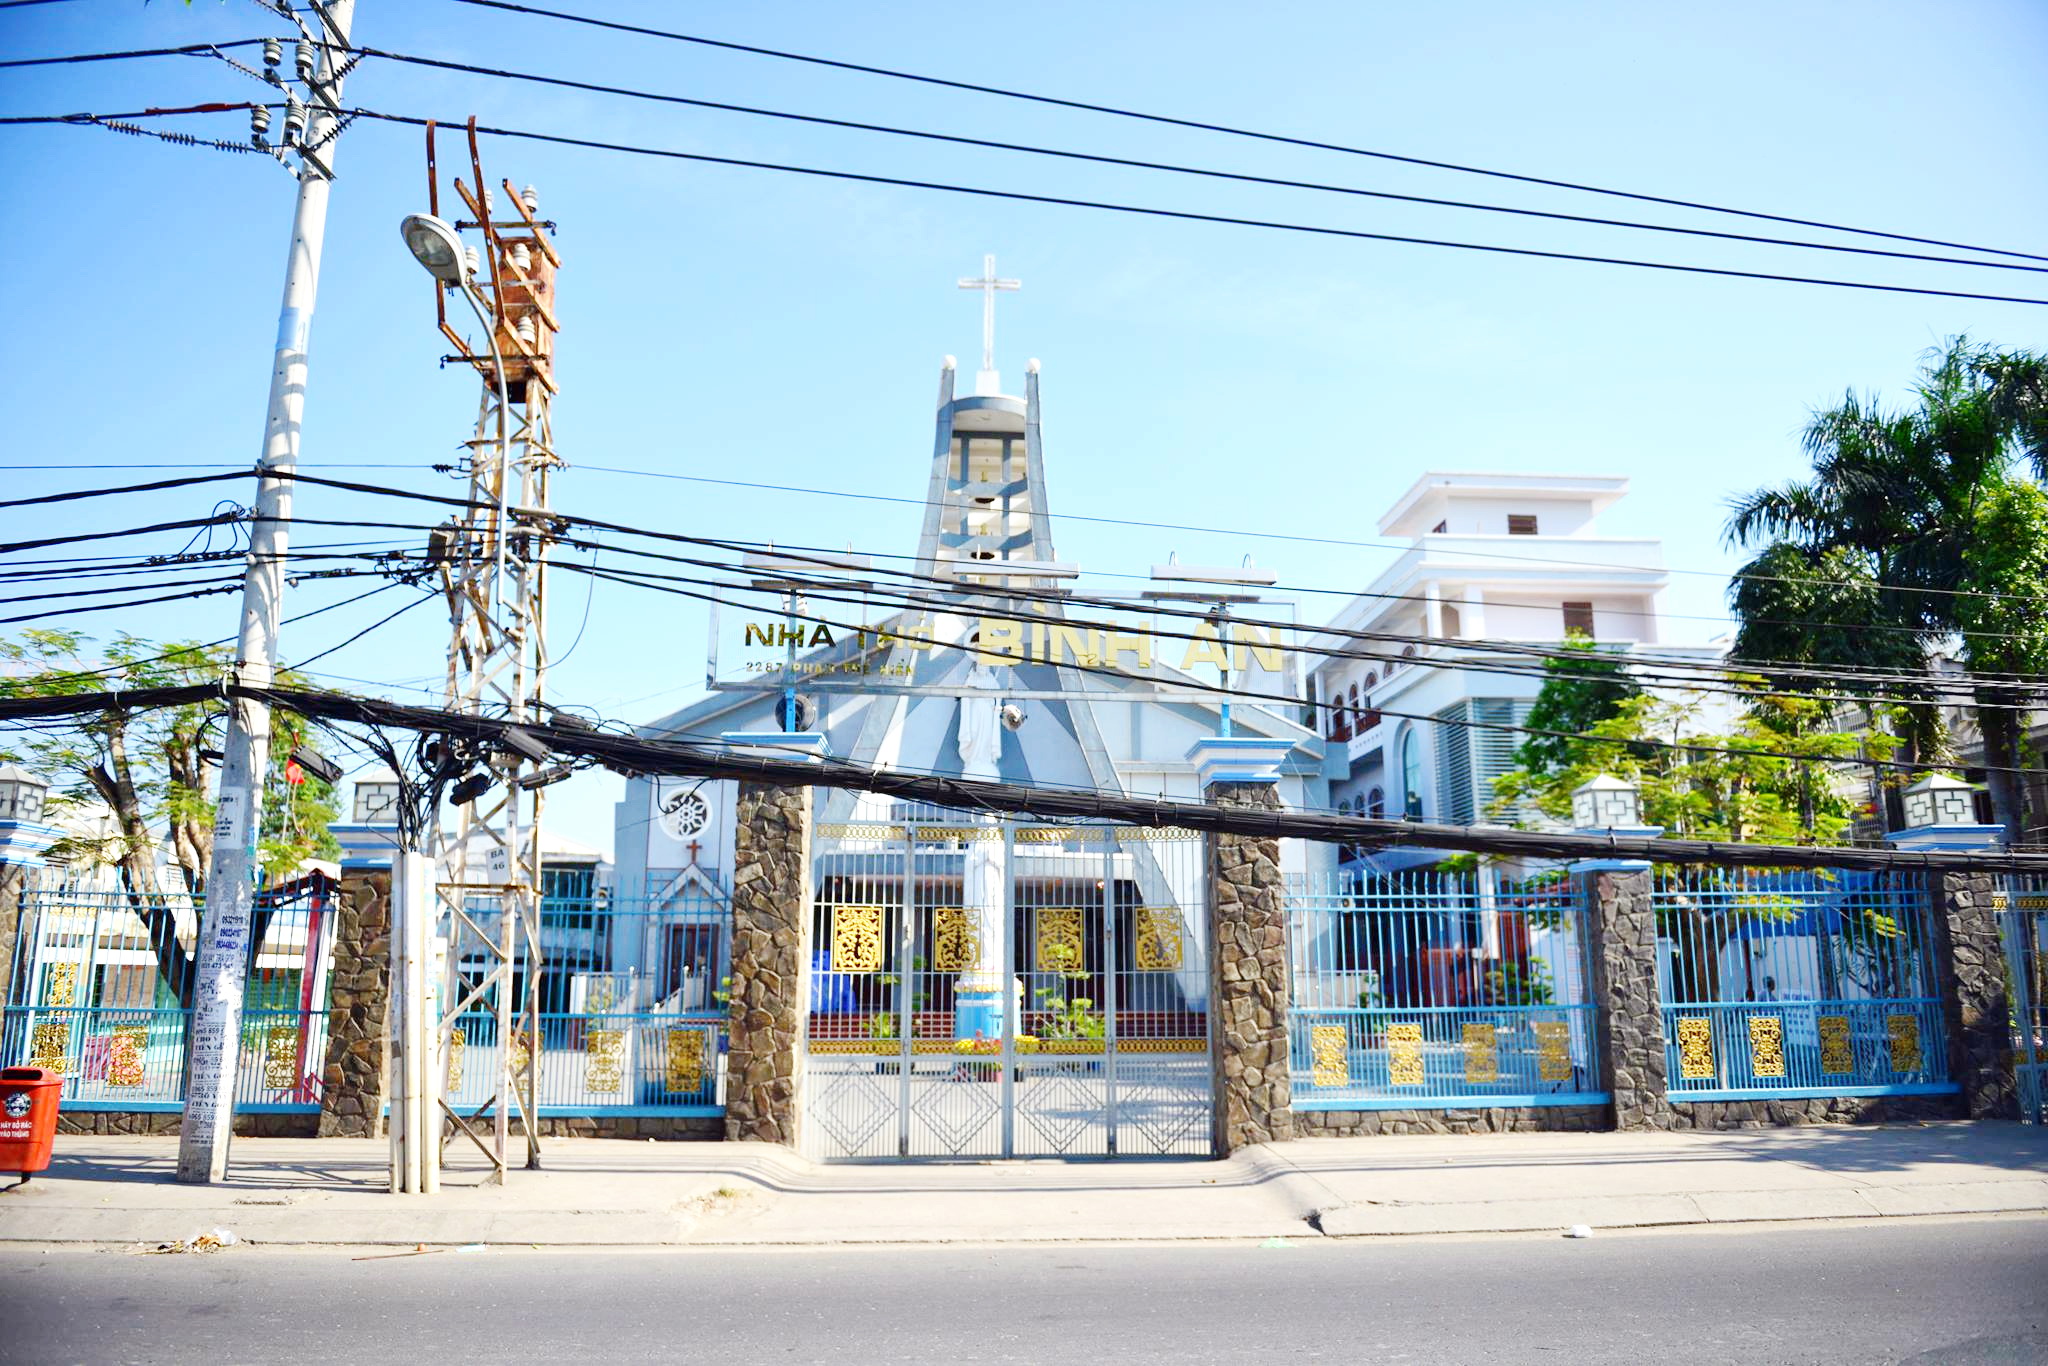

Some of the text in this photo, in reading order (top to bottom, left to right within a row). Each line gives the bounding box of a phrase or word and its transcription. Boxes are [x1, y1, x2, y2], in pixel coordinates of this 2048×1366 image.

[978, 600, 1151, 669] BÌNH
[1180, 621, 1283, 672] AN
[746, 661, 783, 673] 2287
[490, 848, 504, 859] BA
[492, 861, 505, 871] 46
